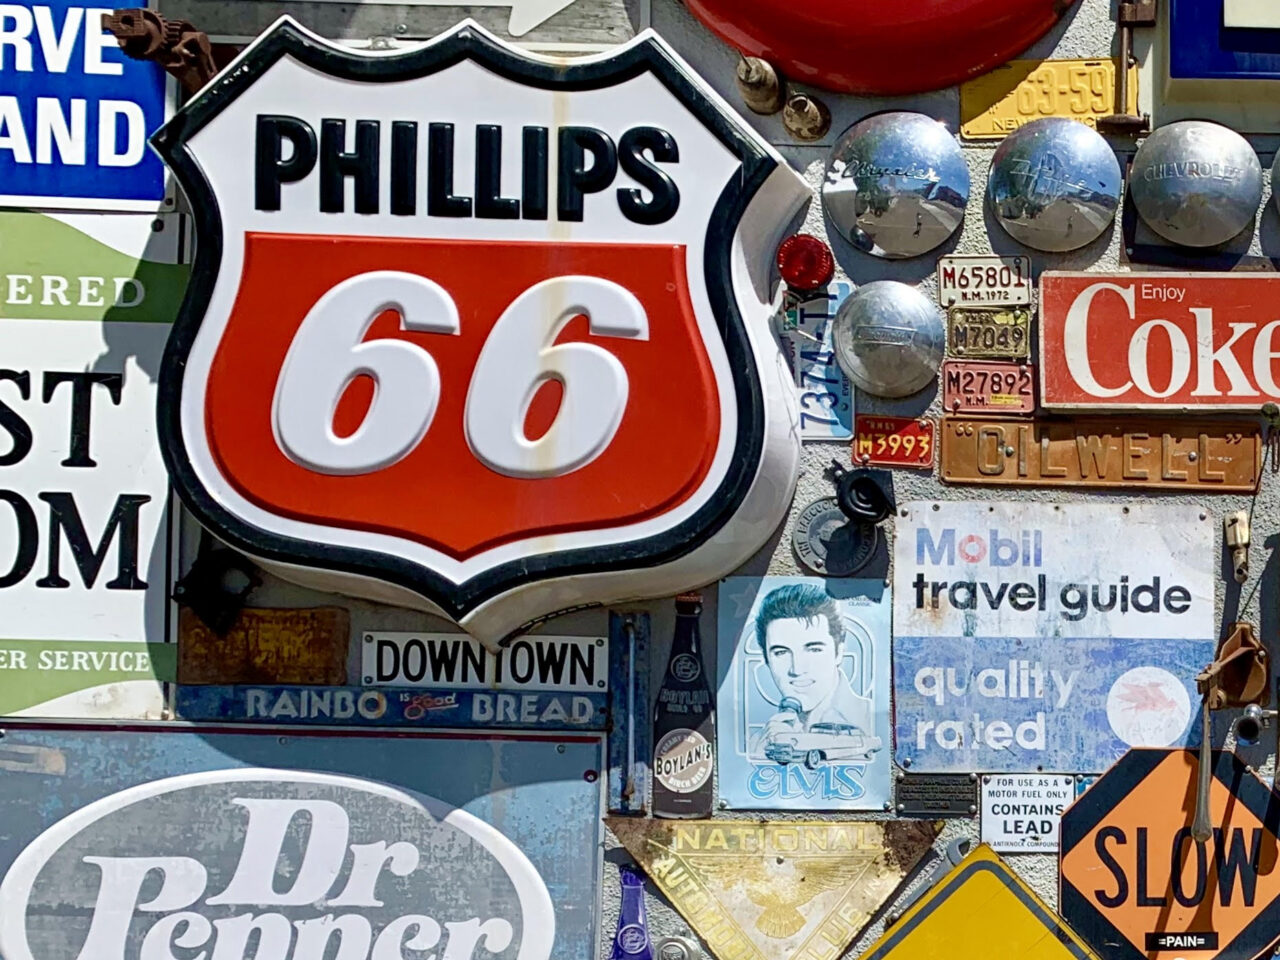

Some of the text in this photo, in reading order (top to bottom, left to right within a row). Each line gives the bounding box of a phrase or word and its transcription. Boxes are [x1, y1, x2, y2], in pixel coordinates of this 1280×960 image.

[254, 114, 681, 225] PHILLIPS
[942, 266, 1026, 289] M65801
[1140, 284, 1187, 302] Enjoy
[271, 270, 650, 477] 66
[915, 528, 1042, 569] Mobil
[912, 573, 1192, 622] travel guide
[376, 638, 596, 687] DOWNTOWN
[912, 660, 1084, 709] quality
[915, 711, 1046, 752] rated
[988, 790, 1068, 799] MOTOR FUEL ONLY
[996, 778, 1059, 787] FOR USE AS A
[991, 803, 1064, 816] CONTAINS
[1003, 820, 1053, 835] LEAD
[206, 798, 420, 908] Dr
[676, 825, 879, 853] NATIONAL
[1094, 825, 1263, 908] SLOW
